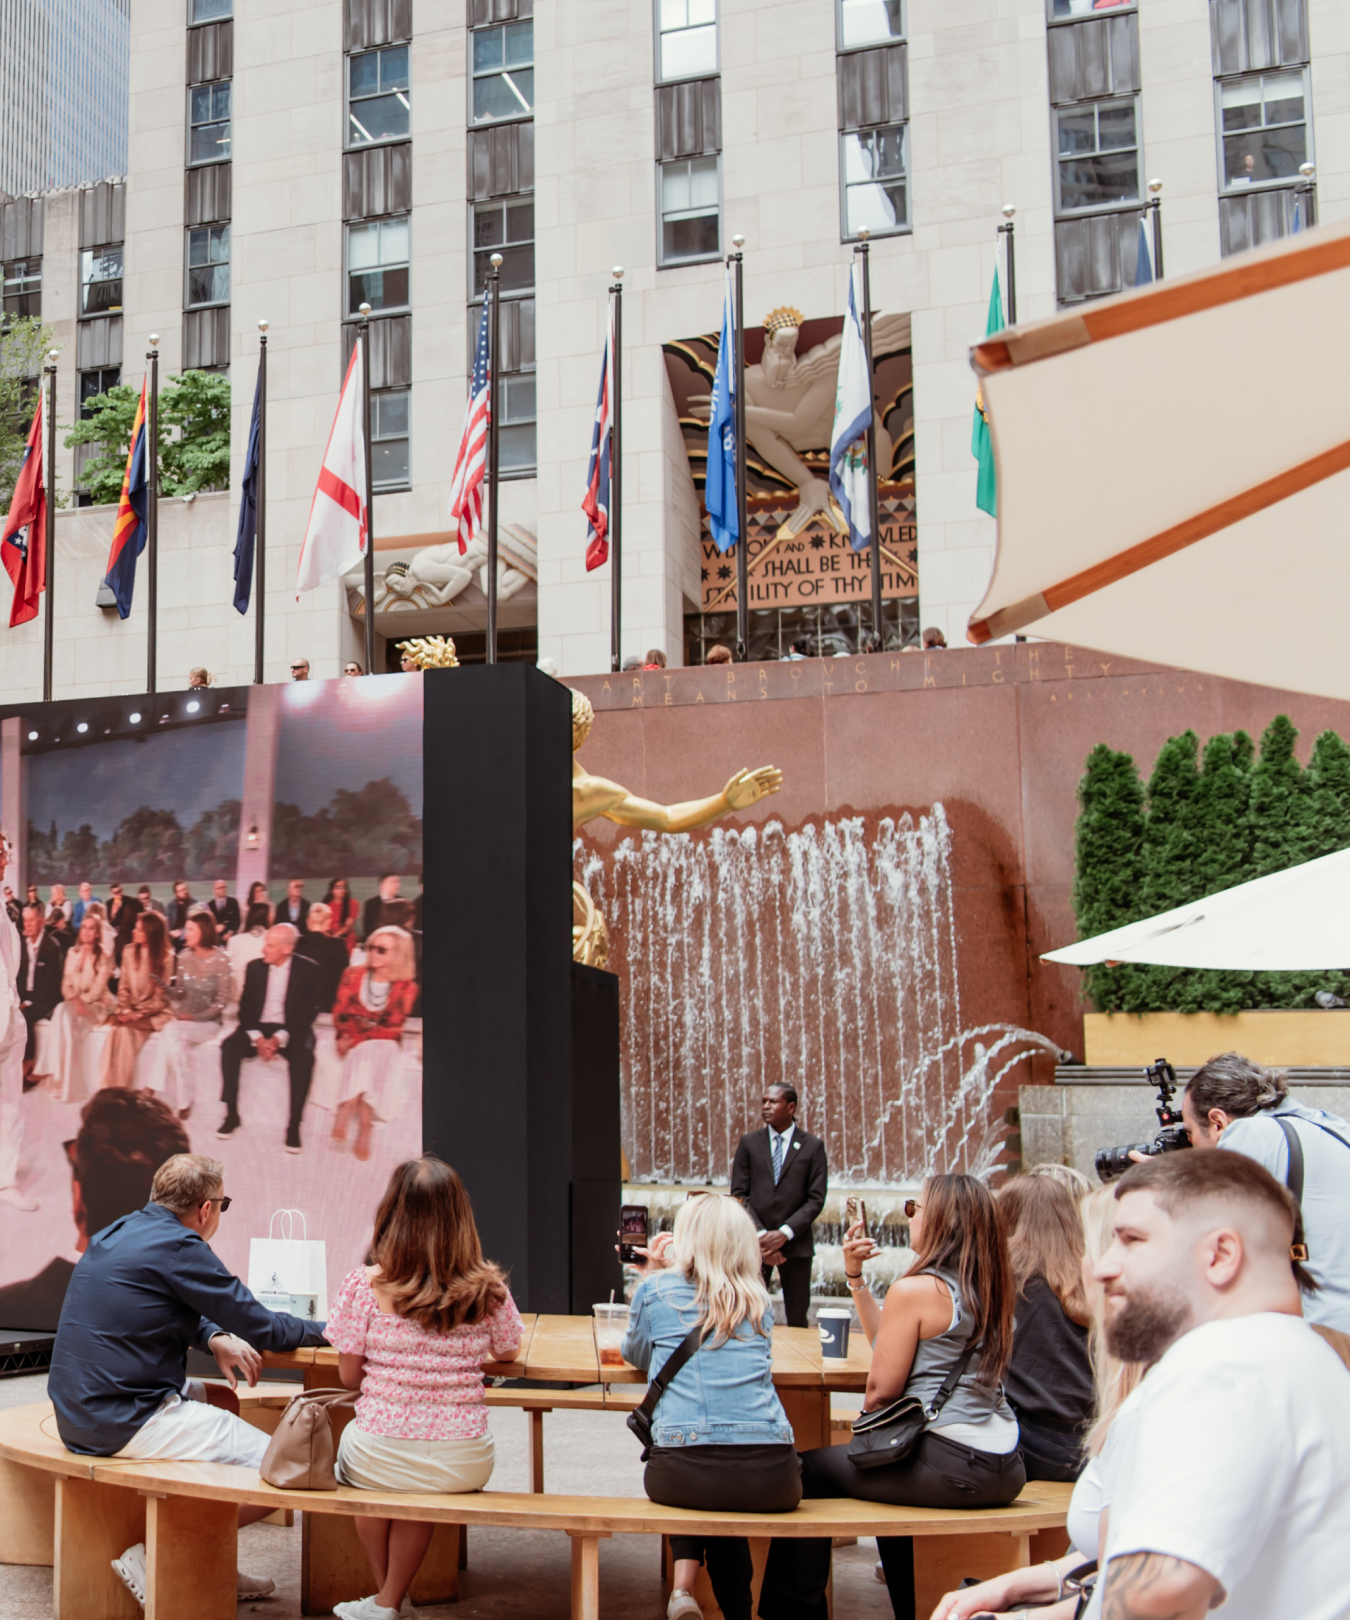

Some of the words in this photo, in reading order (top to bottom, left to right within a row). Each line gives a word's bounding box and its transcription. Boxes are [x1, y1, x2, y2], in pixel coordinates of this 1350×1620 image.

[784, 542, 805, 554] AND
[762, 557, 815, 577] SHALL
[820, 555, 840, 573] BE
[847, 552, 871, 570] THE
[703, 581, 793, 605] STAILITY
[798, 578, 824, 597] OF
[830, 574, 868, 594] THY
[994, 646, 1074, 665] THE
[824, 680, 868, 695] TO
